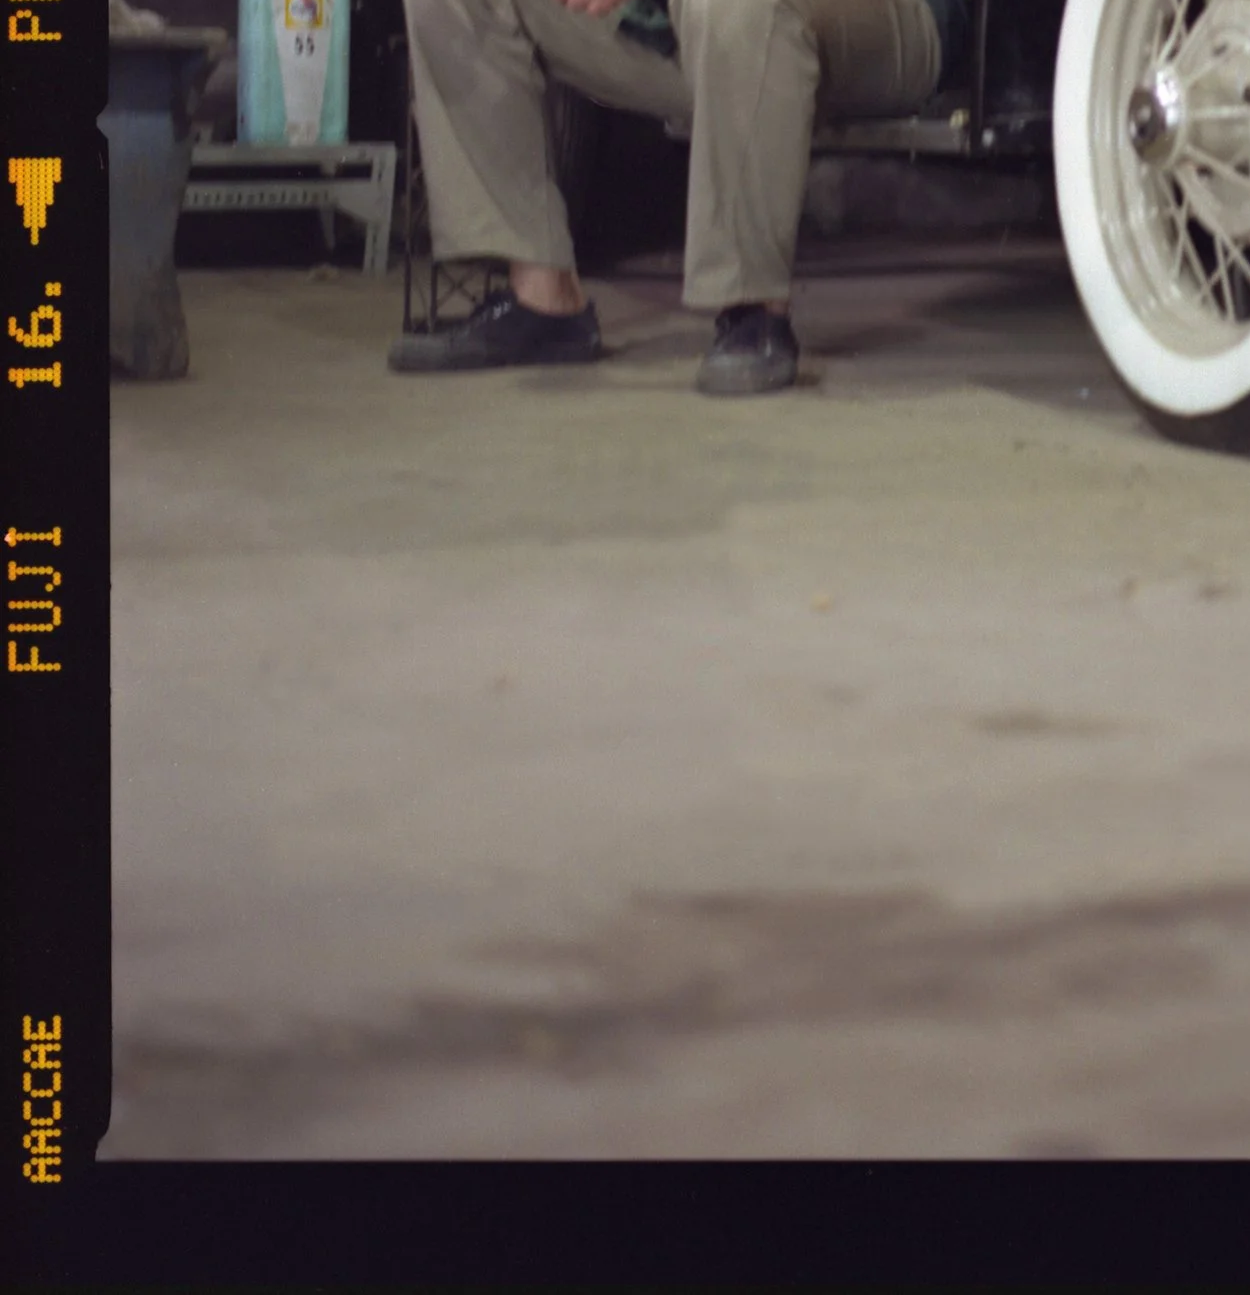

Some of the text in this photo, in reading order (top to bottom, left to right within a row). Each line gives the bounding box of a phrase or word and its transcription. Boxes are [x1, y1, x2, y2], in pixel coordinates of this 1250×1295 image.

[7, 281, 62, 389] 16.
[7, 526, 62, 672] FUJI
[22, 1015, 62, 1183] AACCAE
